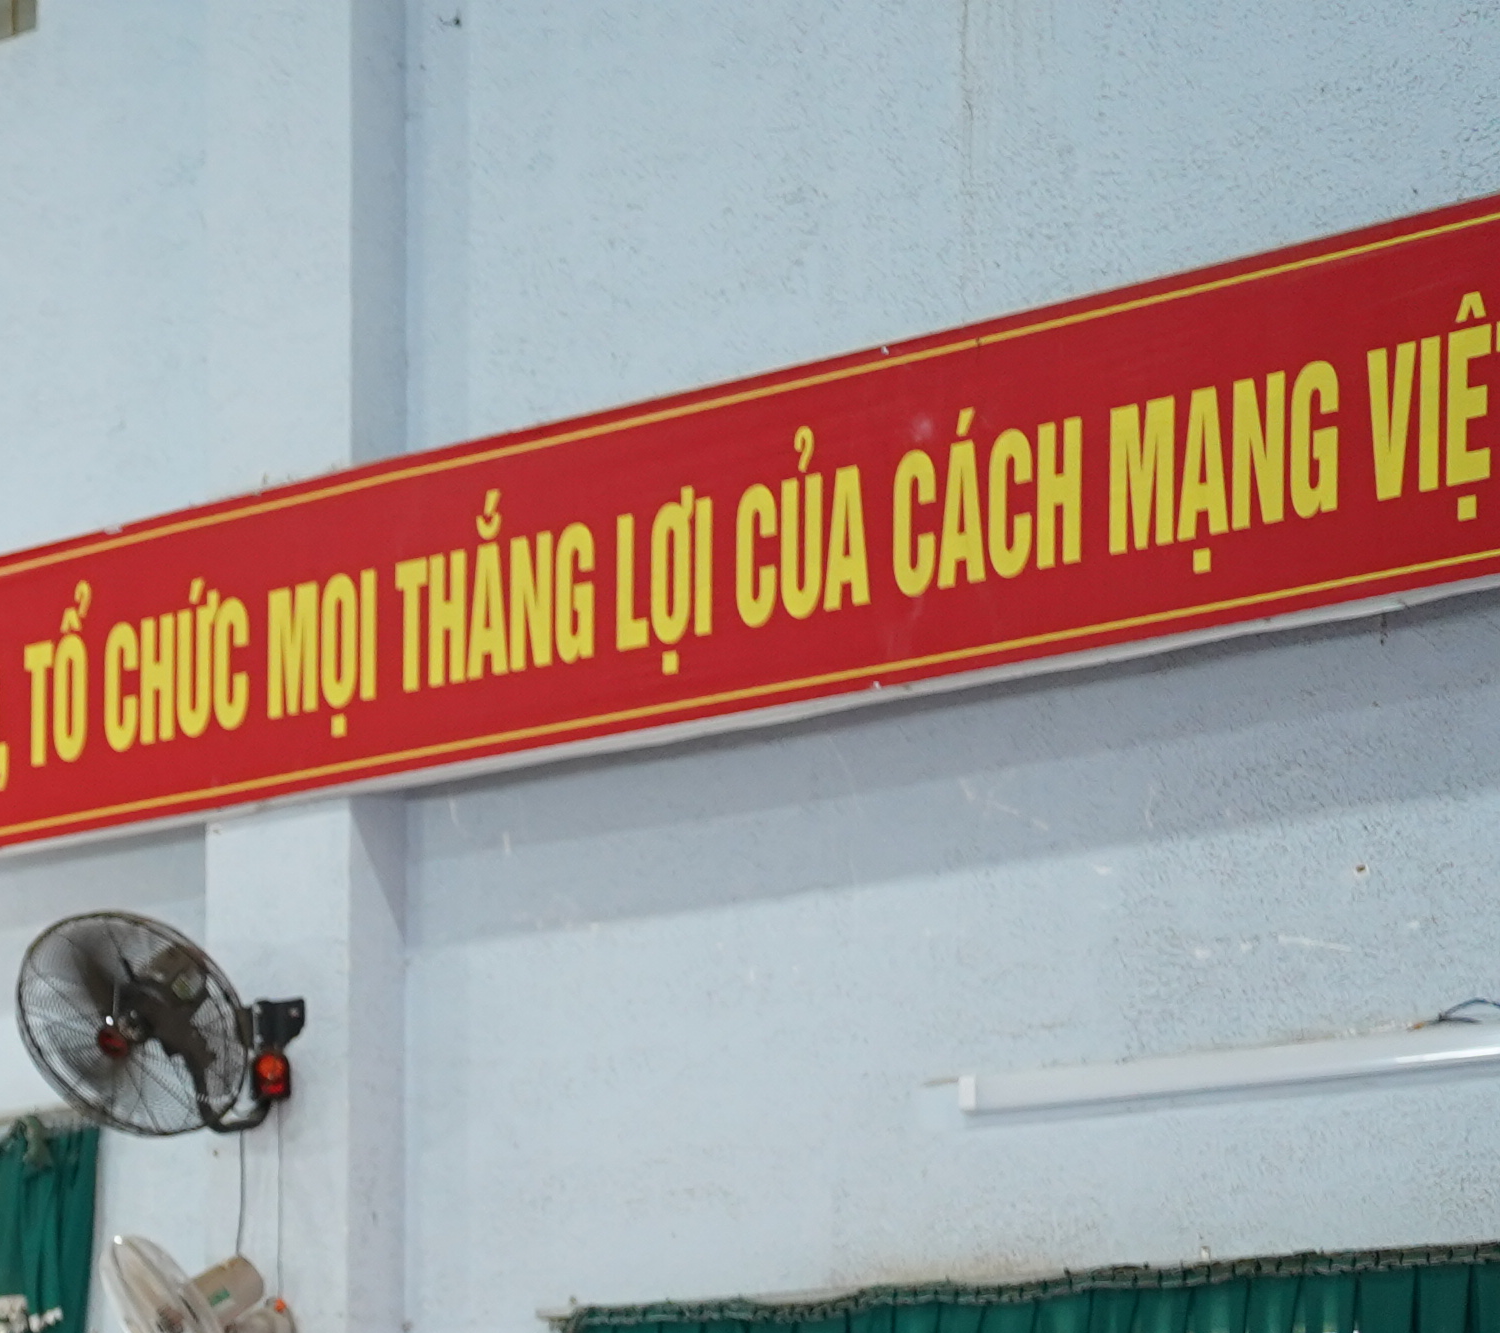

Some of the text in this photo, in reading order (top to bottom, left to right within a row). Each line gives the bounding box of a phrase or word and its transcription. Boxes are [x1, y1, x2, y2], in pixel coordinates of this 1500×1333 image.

[24, 581, 90, 766] TỔ
[105, 578, 249, 752] CHỨC
[268, 569, 376, 737] MỌI
[395, 489, 594, 692] THẮNG
[616, 486, 712, 674] LỢI
[735, 425, 871, 627] CỦA
[892, 408, 1083, 599] CÁCH
[1109, 361, 1338, 573] MẠNG
[1367, 291, 1500, 521] VIỆ
